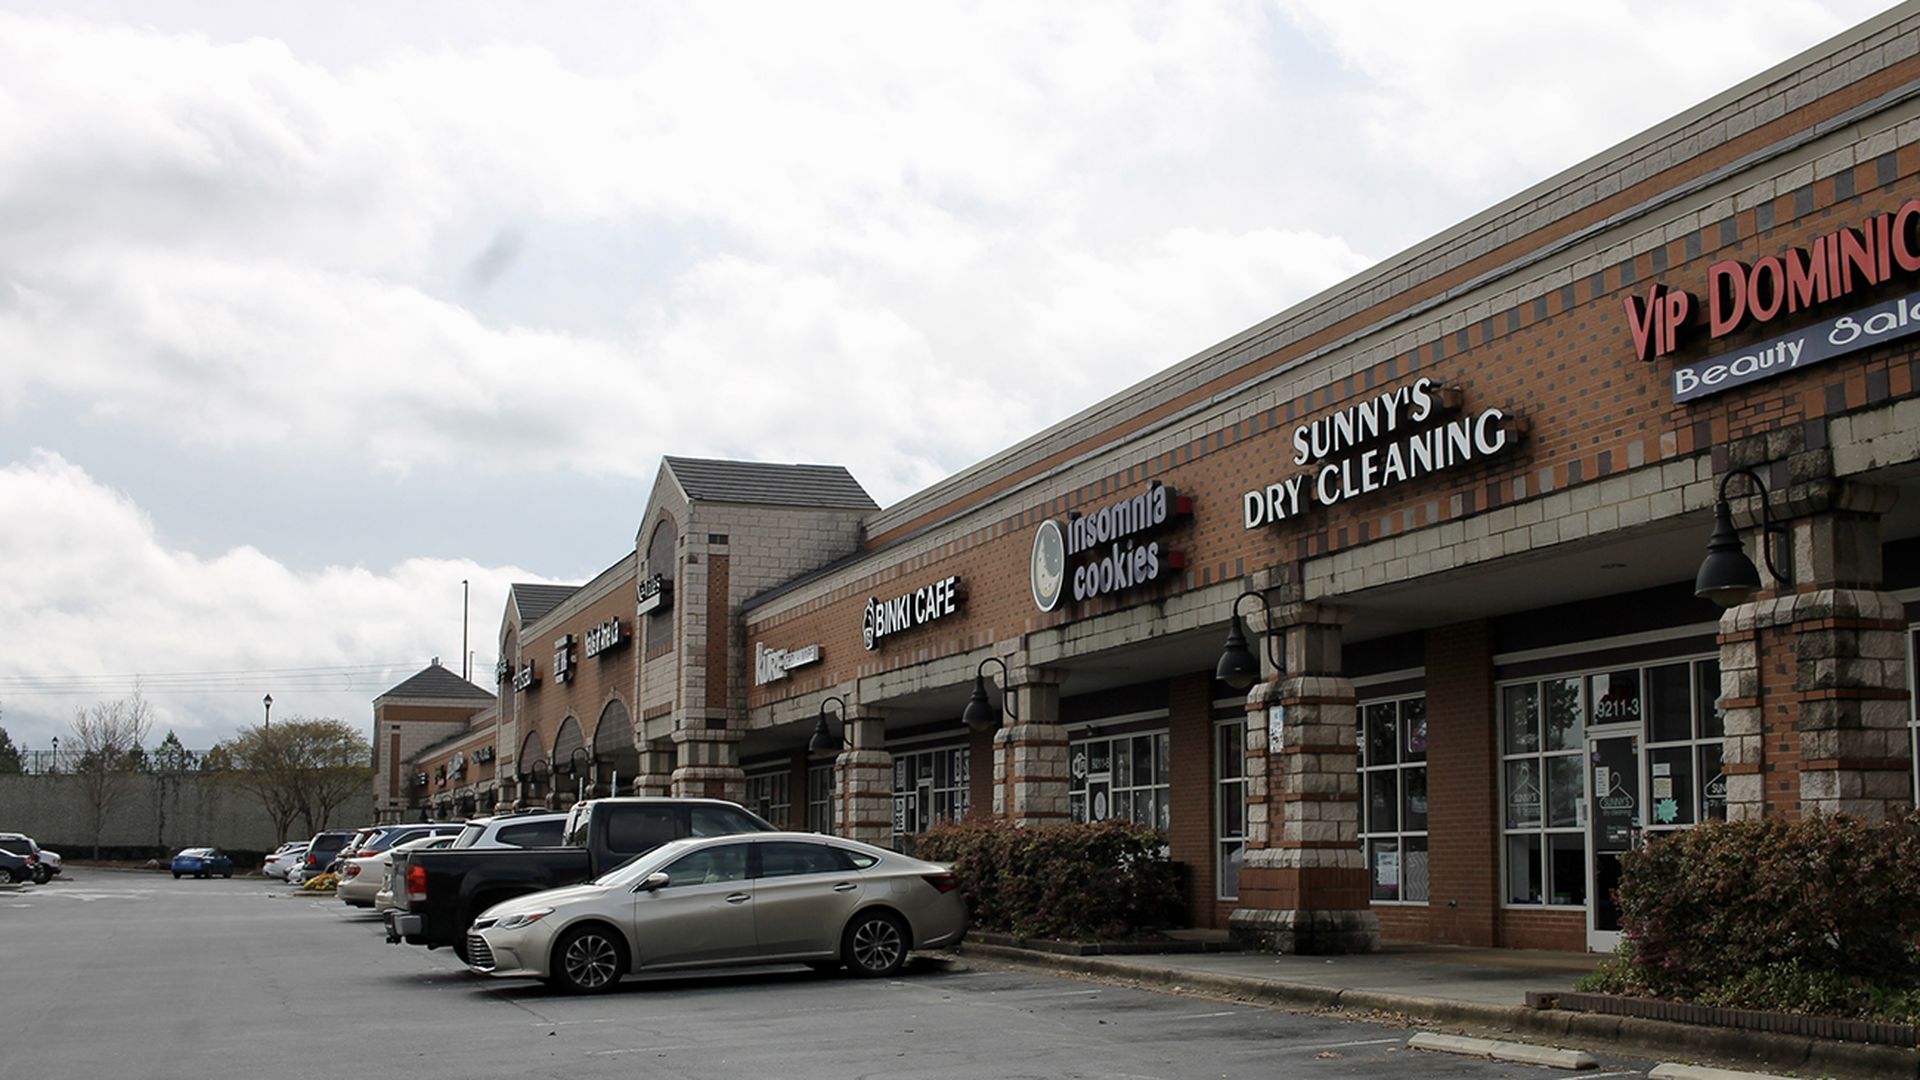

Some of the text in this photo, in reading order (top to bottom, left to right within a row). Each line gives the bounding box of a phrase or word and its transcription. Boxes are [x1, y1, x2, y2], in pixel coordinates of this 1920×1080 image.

[1675, 338, 1804, 395] Beauty
[1293, 377, 1432, 466] SUNNY'S
[1244, 408, 1506, 530] DRY CLEANING
[1067, 480, 1166, 556] insomnia
[1073, 538, 1159, 601] cookies
[875, 575, 955, 638] BINKI CAFE
[1598, 698, 1640, 718] 9211-3
